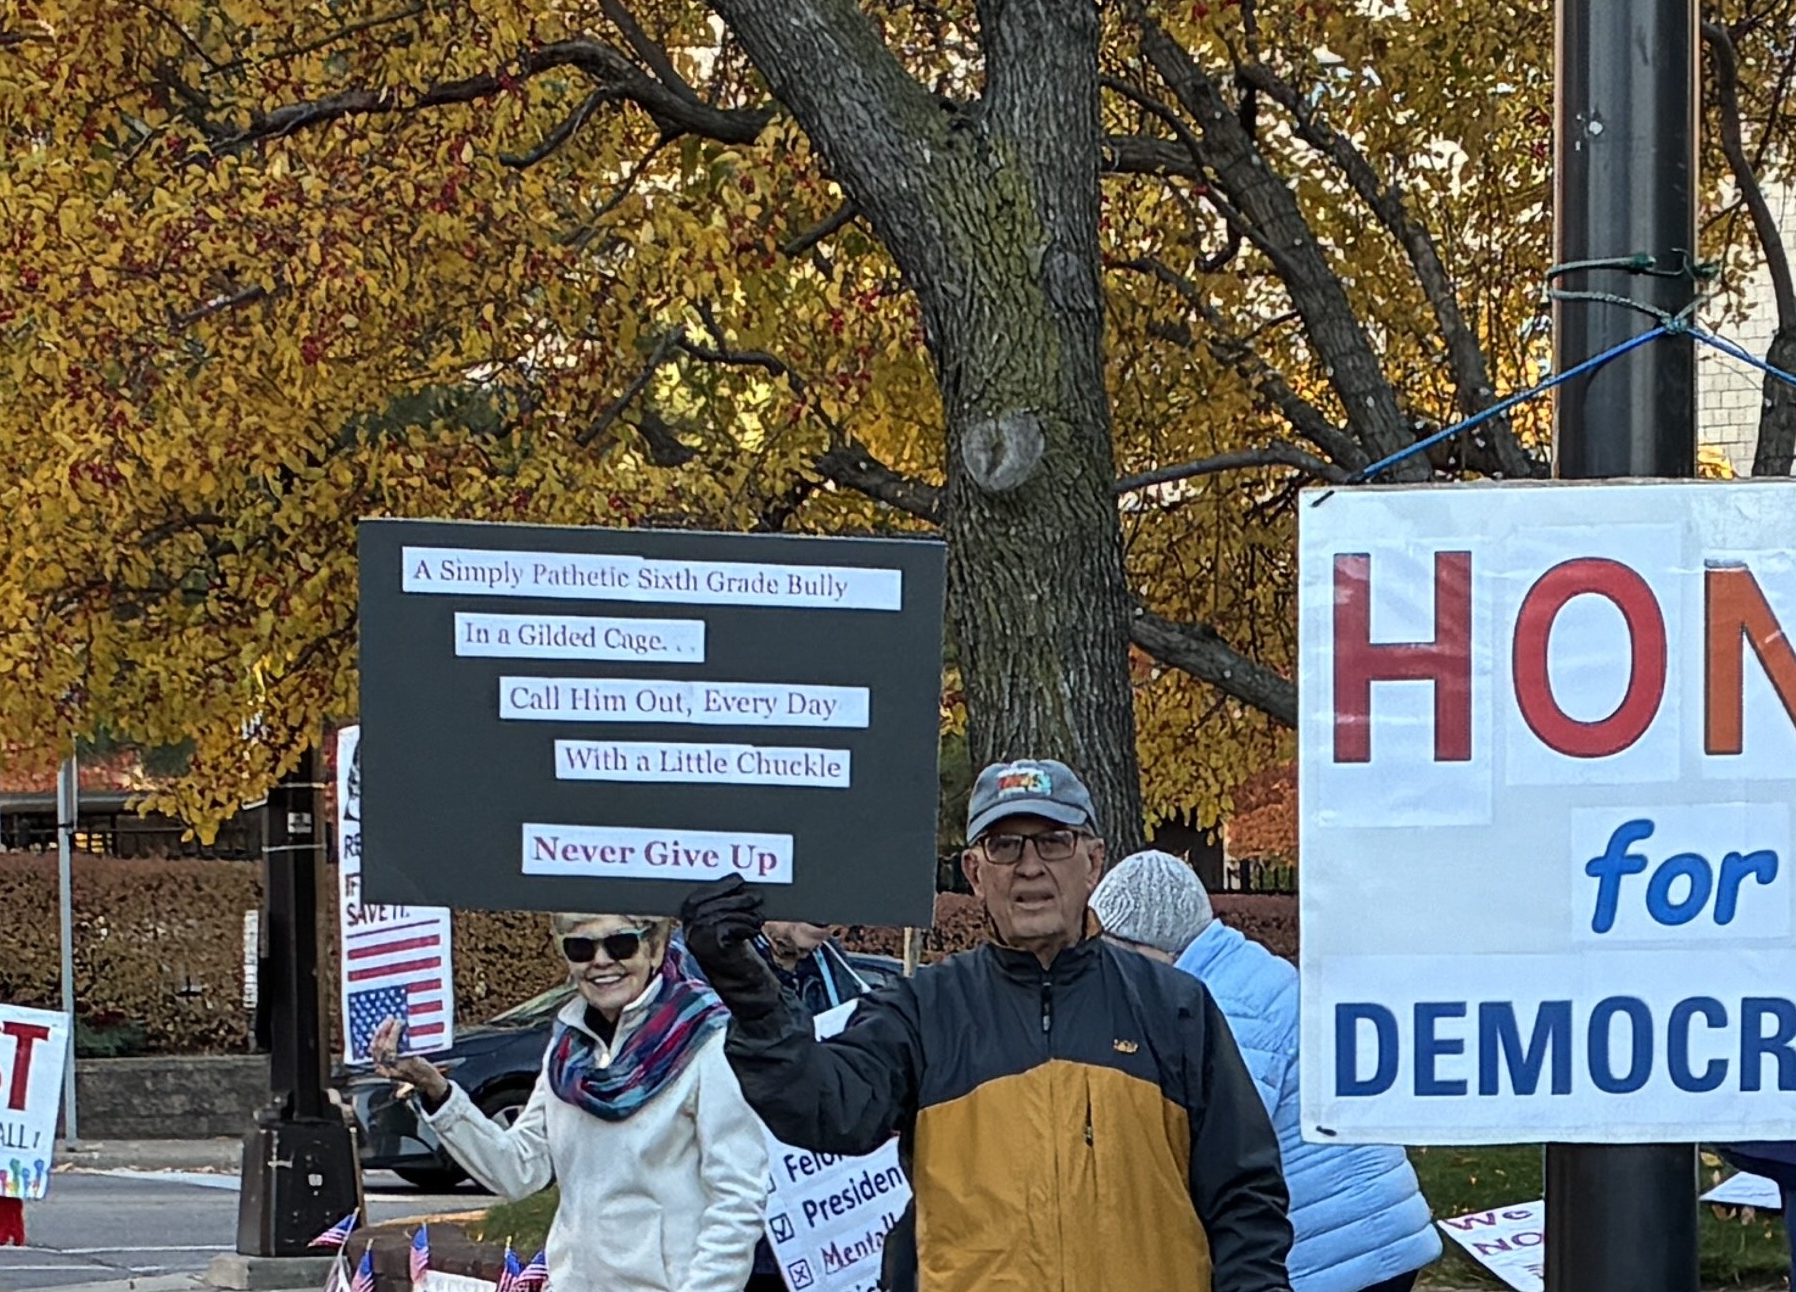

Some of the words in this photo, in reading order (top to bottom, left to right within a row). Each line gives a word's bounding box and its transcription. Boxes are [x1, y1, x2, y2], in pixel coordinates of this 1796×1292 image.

[412, 559, 433, 580] A
[439, 558, 523, 589] Simply
[532, 563, 631, 588] Pathetic
[637, 567, 698, 591] Sixth
[706, 570, 779, 595] Grade
[787, 573, 848, 602] Bully
[464, 621, 490, 645] In
[497, 627, 512, 646] a
[517, 624, 597, 648] Gilded
[509, 685, 560, 711] Call
[570, 687, 627, 712] Him
[635, 688, 693, 718] Out,
[703, 689, 778, 719] Every
[786, 691, 838, 721] Day
[564, 746, 628, 772] With
[636, 755, 650, 772] a
[659, 749, 728, 775] Little
[736, 752, 841, 778] Chuckle
[532, 835, 636, 867] Never
[643, 840, 720, 869] Give
[730, 843, 779, 877] Up
[1585, 817, 1780, 936] for
[802, 1165, 903, 1229] Presiden
